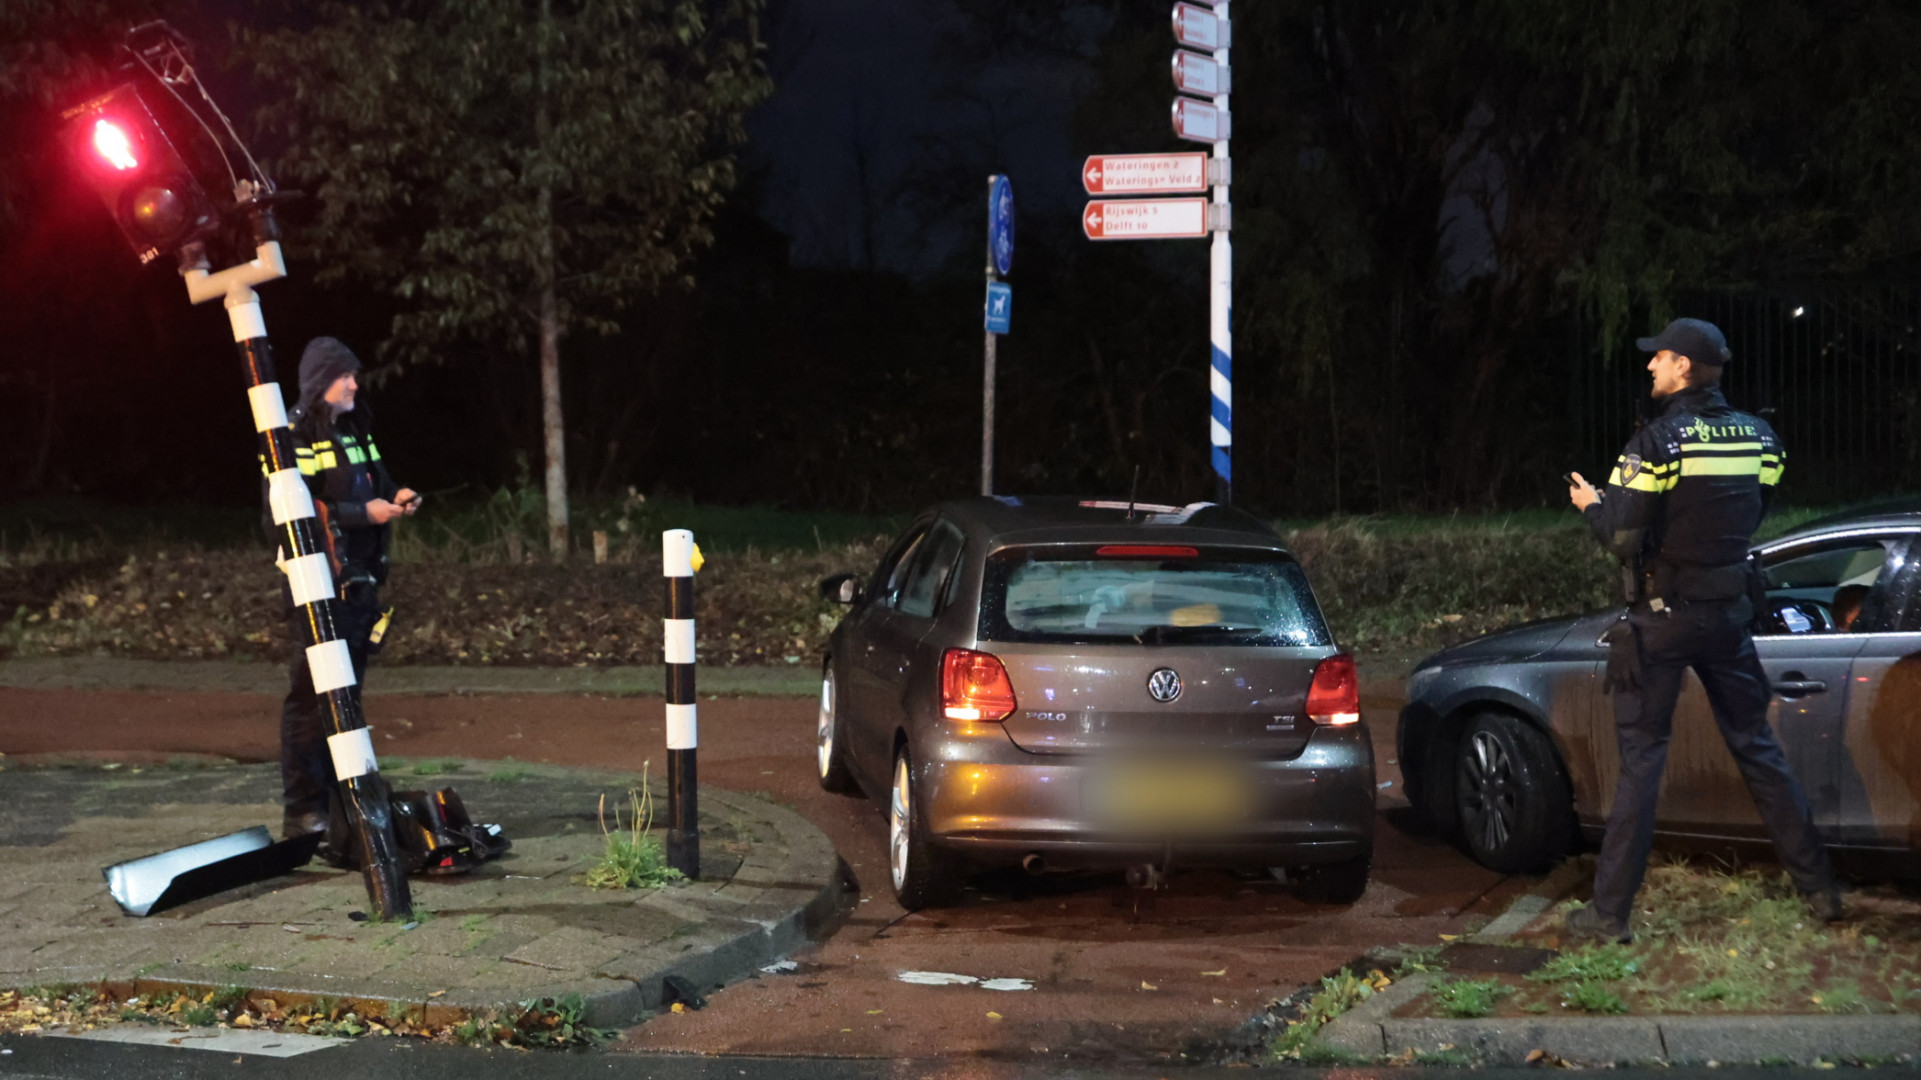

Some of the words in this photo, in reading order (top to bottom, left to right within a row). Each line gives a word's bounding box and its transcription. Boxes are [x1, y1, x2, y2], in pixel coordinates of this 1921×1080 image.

[1105, 161, 1170, 171] Wateringen
[1173, 160, 1179, 169] 2
[1169, 174, 1192, 183] Veld
[1106, 206, 1149, 217] Rijswijk
[1106, 221, 1133, 230] Delft
[1137, 222, 1148, 230] 10
[1685, 422, 1755, 442] POLITIE
[1026, 711, 1067, 721] POLO
